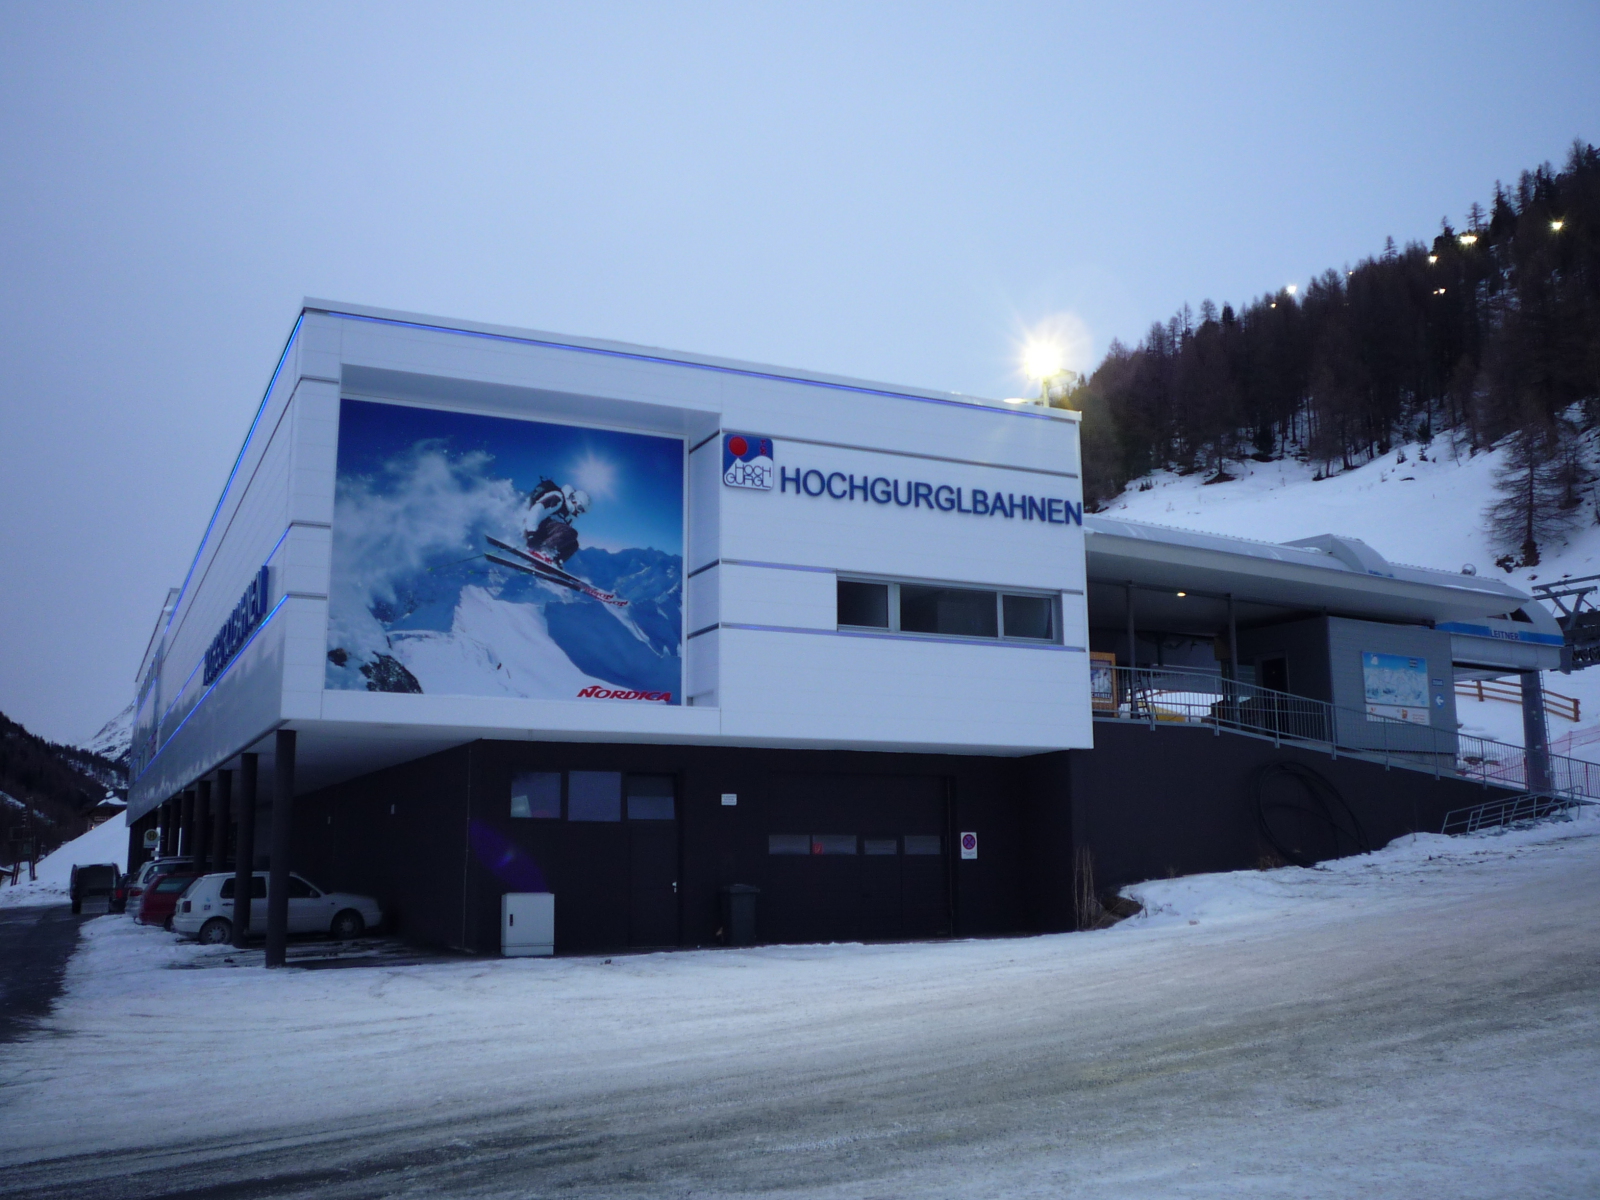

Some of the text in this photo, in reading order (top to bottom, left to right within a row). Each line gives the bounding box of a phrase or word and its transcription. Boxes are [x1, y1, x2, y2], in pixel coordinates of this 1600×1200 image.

[734, 463, 772, 477] HOCH
[726, 472, 771, 488] GURGL
[780, 466, 1082, 526] HOCHGURGLBAHNEN
[1489, 629, 1520, 640] LEITNER
[577, 685, 672, 702] NORDICA
